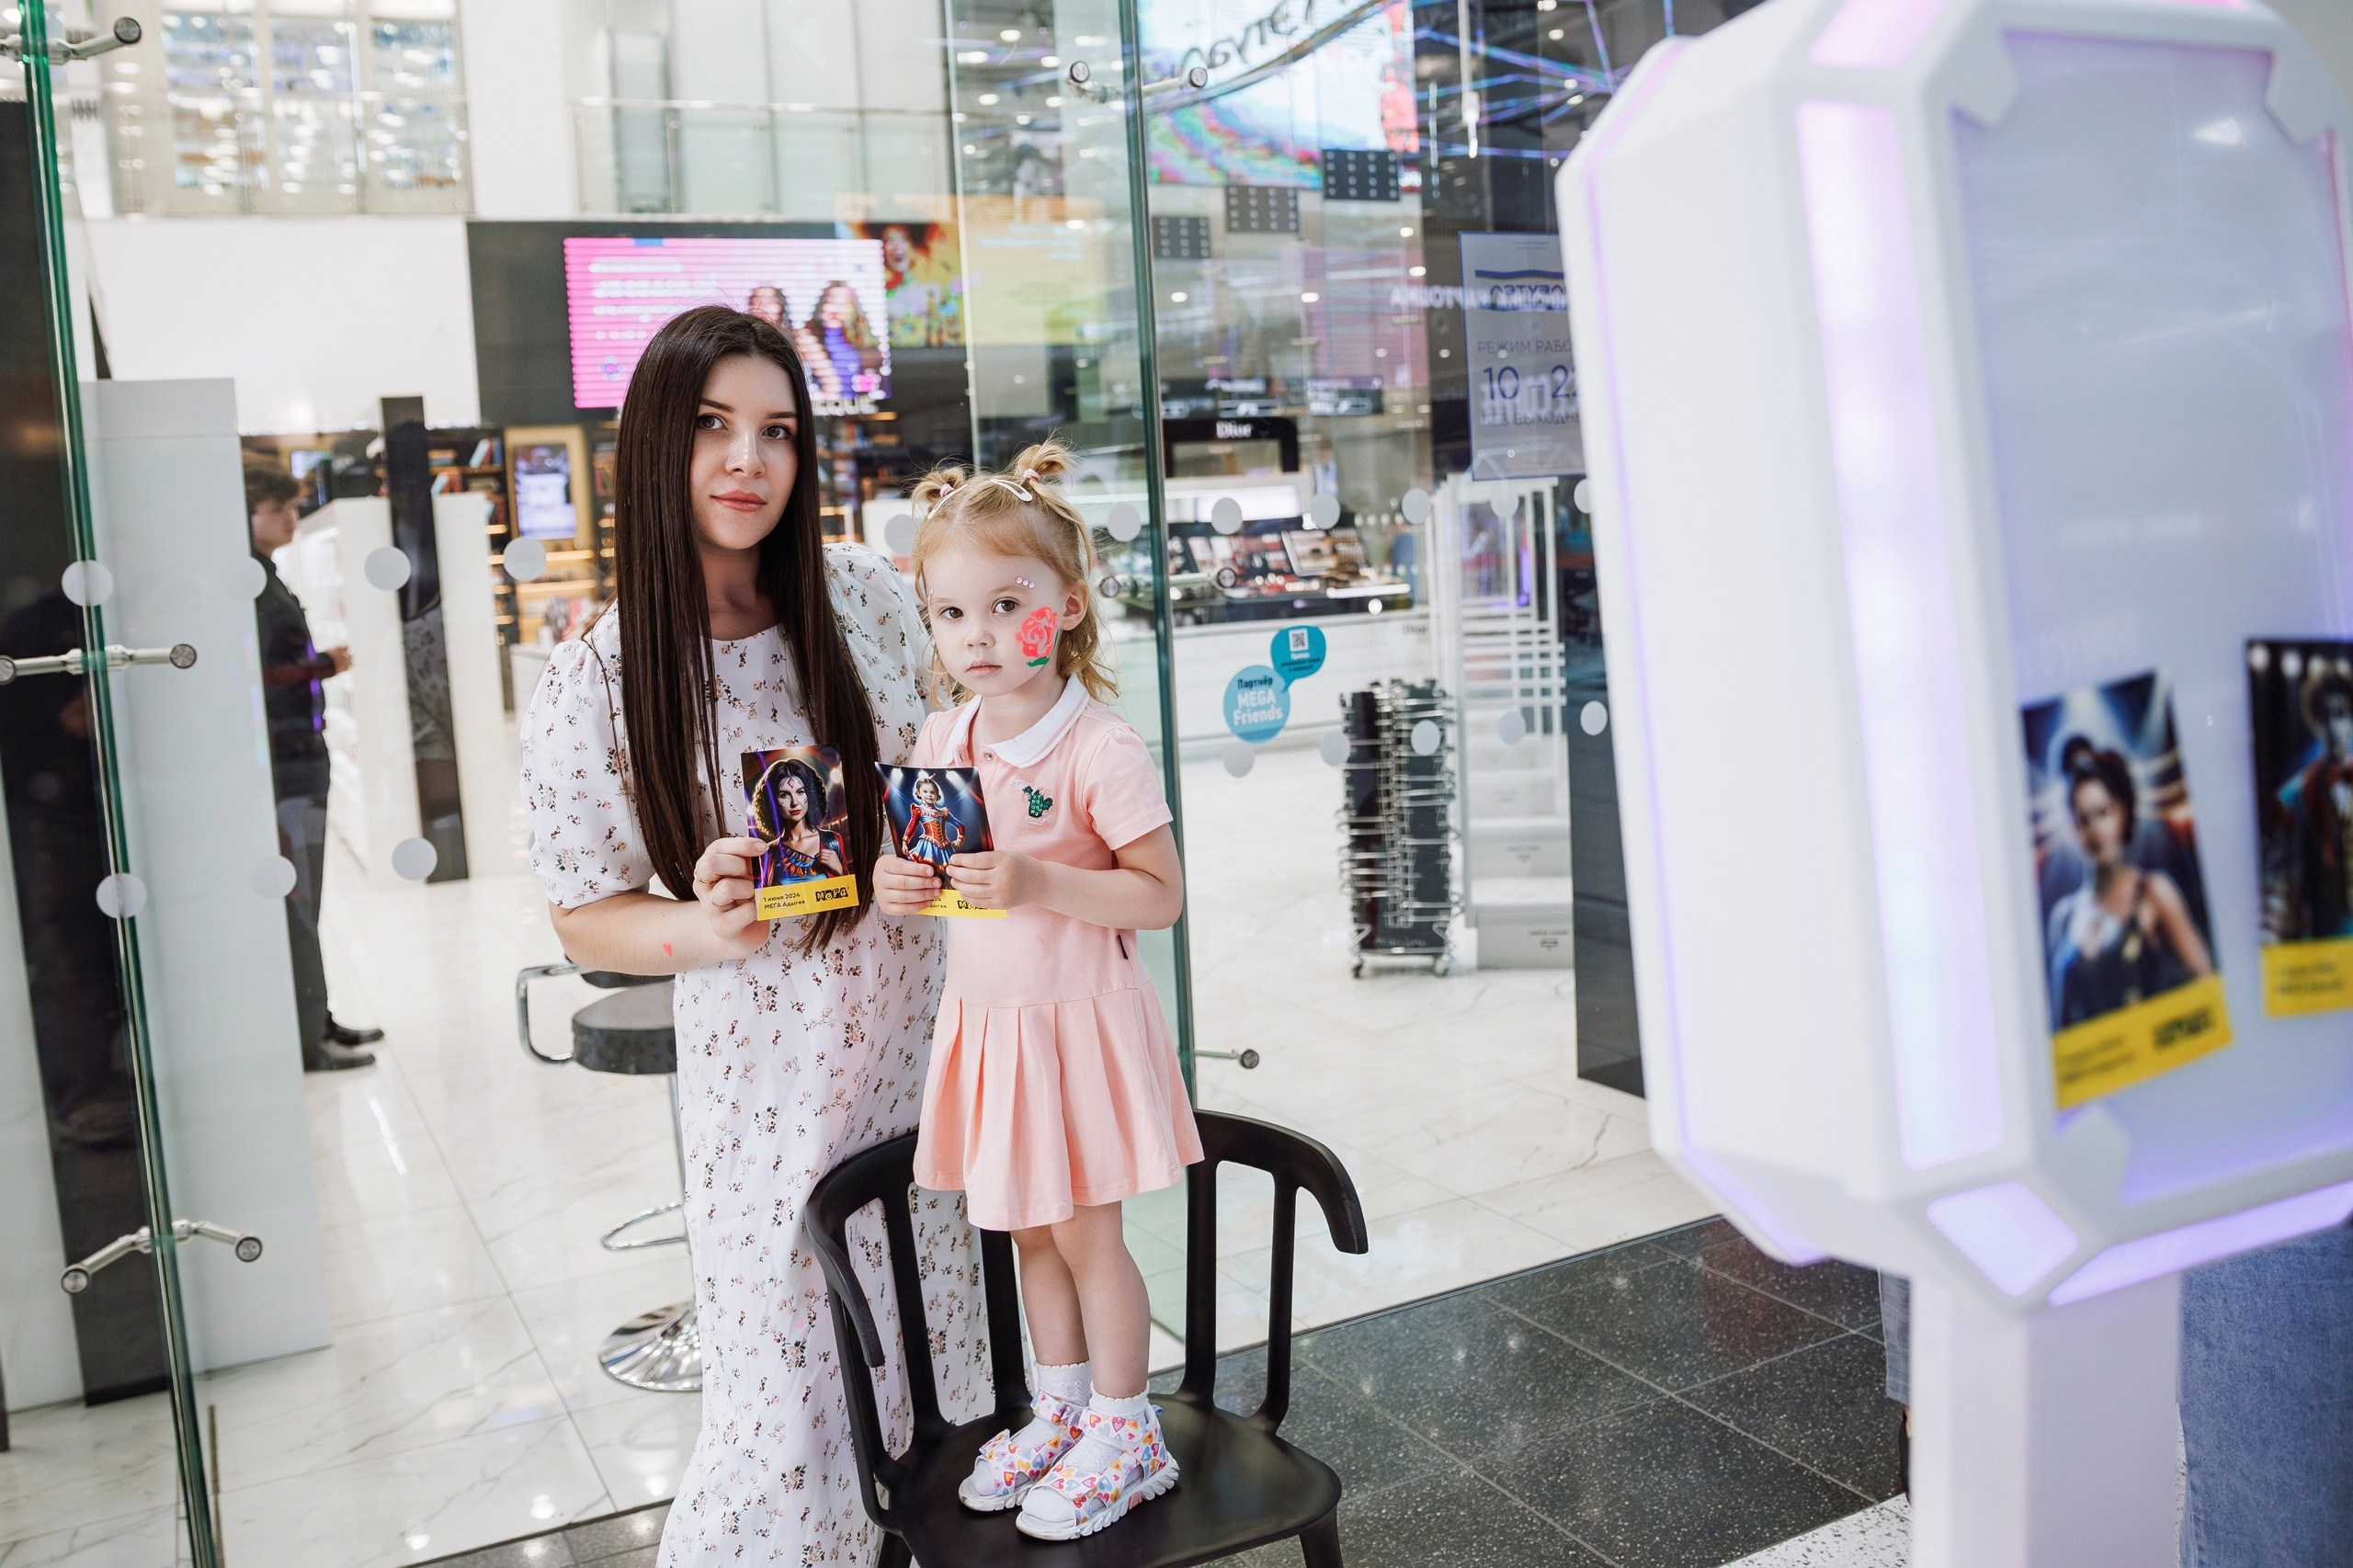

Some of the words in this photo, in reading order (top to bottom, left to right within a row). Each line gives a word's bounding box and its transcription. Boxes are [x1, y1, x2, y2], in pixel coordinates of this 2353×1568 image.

[1477, 340, 1531, 354] РЕЖИМ
[1483, 366, 1519, 401] 10
[1551, 364, 1578, 399] 2
[1237, 676, 1273, 689] Партнёр
[1237, 687, 1276, 709] MEGA
[1233, 704, 1283, 726] Friends
[764, 902, 781, 910] МЕГА
[782, 900, 805, 908] Адыгея
